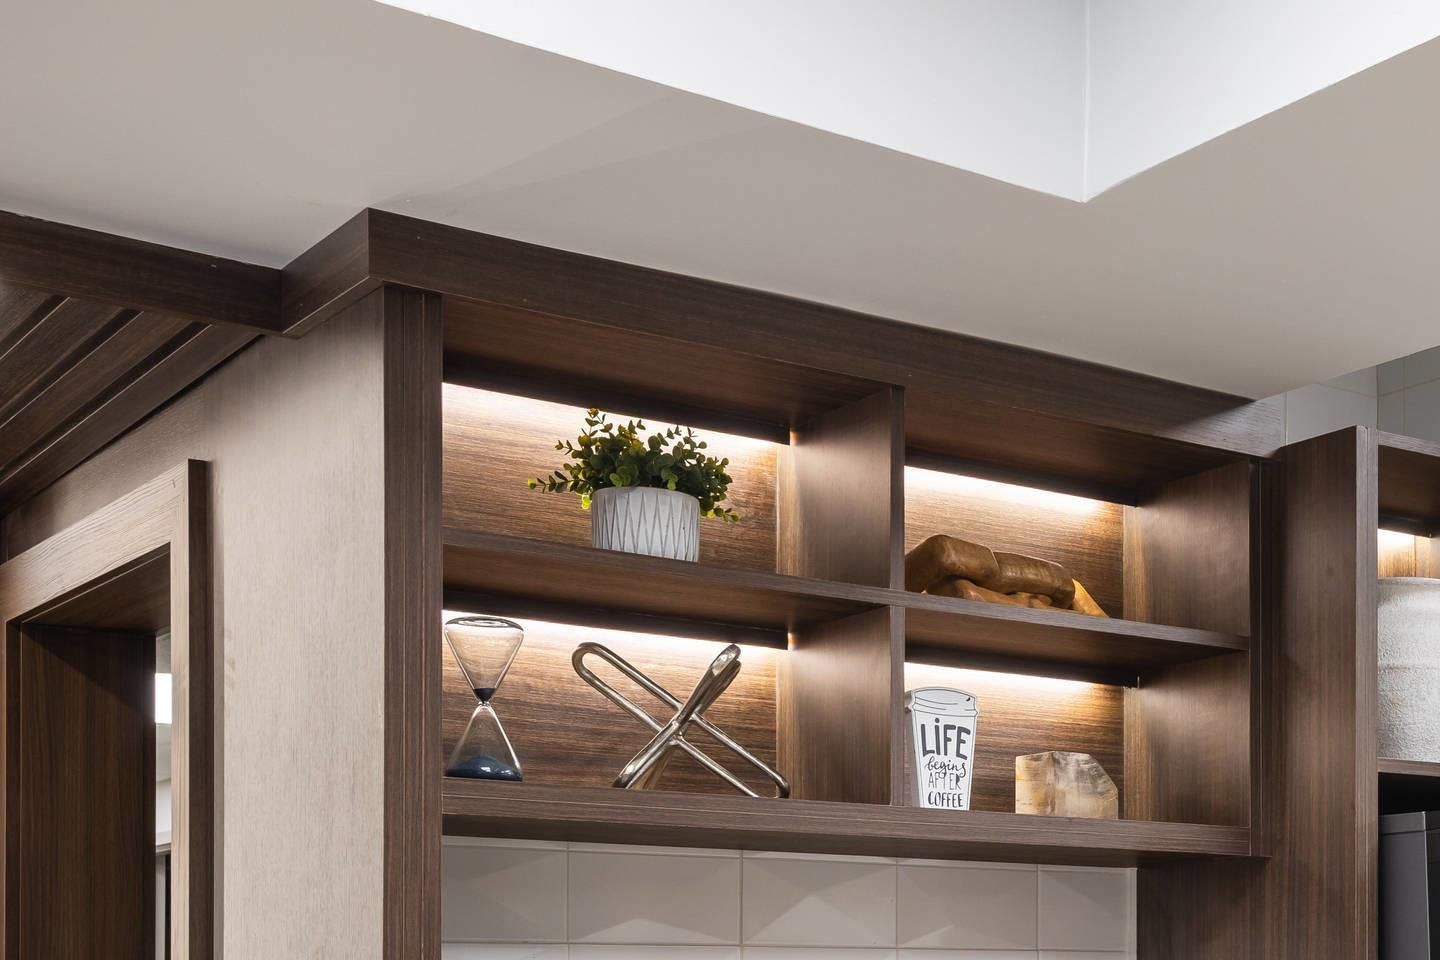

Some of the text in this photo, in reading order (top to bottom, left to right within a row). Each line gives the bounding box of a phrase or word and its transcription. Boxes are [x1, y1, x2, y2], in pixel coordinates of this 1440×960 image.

[924, 756, 967, 778] begins
[928, 772, 962, 790] AFTER
[928, 791, 963, 808] COFFEE
